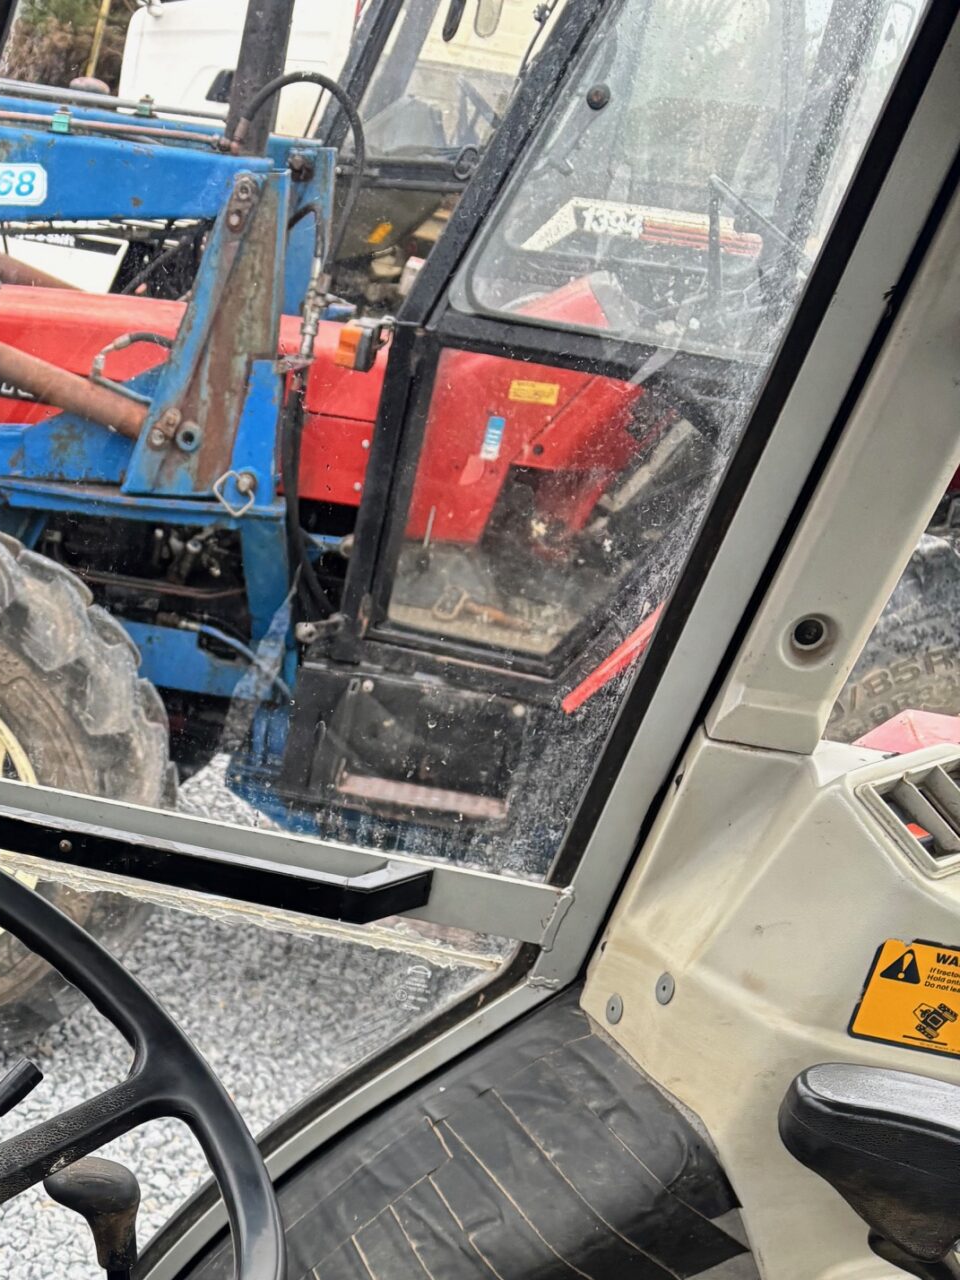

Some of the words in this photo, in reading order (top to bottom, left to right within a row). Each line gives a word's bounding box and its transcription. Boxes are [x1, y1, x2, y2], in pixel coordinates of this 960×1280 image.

[582, 206, 643, 239] 1394
[936, 952, 960, 968] WA
[924, 980, 936, 988] Do
[927, 974, 946, 983] Hold
